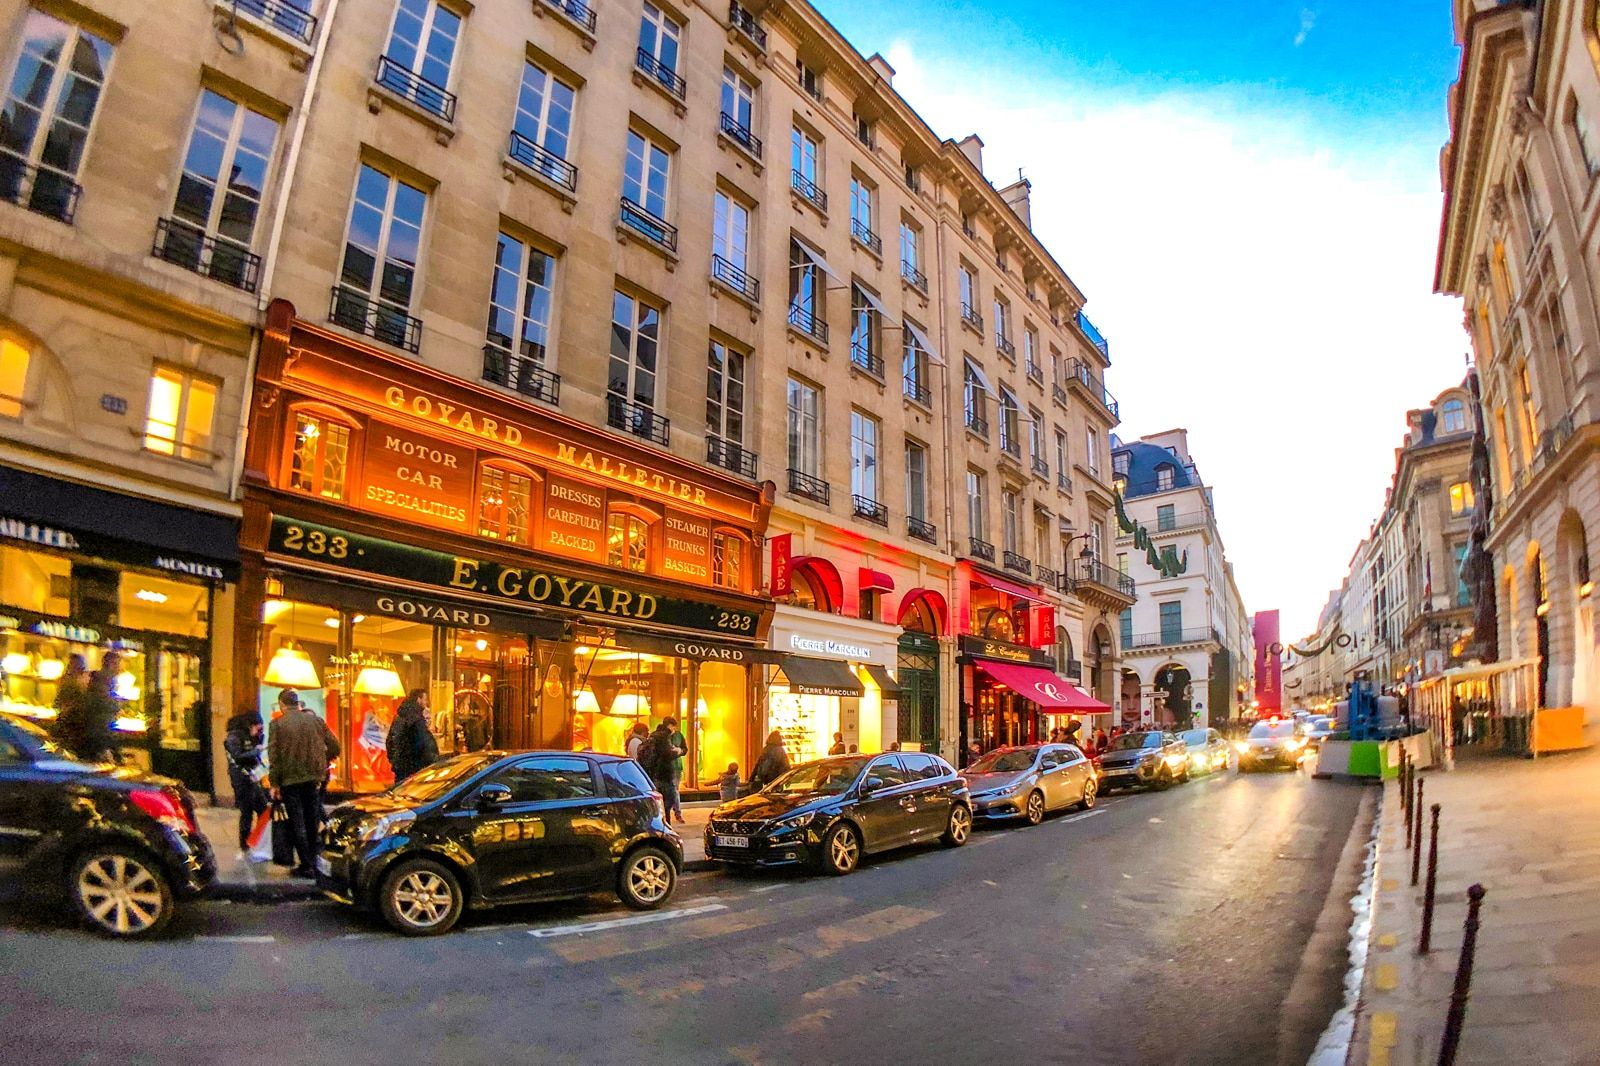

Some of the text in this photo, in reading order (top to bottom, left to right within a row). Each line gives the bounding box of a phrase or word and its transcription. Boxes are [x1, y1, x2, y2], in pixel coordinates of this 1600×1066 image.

[384, 435, 458, 470] MOTOR
[385, 386, 708, 507] GOYARD MALLETIER
[396, 466, 444, 491] CAR
[366, 485, 467, 524] SPECIALITIES
[550, 484, 602, 509] DRESSES
[547, 506, 602, 532] CAREFULLY
[666, 516, 709, 539] STEAMER
[283, 526, 349, 559] 233
[549, 530, 597, 554] PACKED
[667, 537, 706, 557] TRUNKS
[664, 556, 708, 578] BASKETS
[376, 597, 491, 628] GOYARD
[717, 613, 751, 632] 233
[1043, 615, 1051, 639] BAR
[674, 643, 744, 661] GOYARD
[791, 634, 872, 657] PIERRE MARCOLINI
[798, 684, 859, 697] PIERRE MARCOLINI
